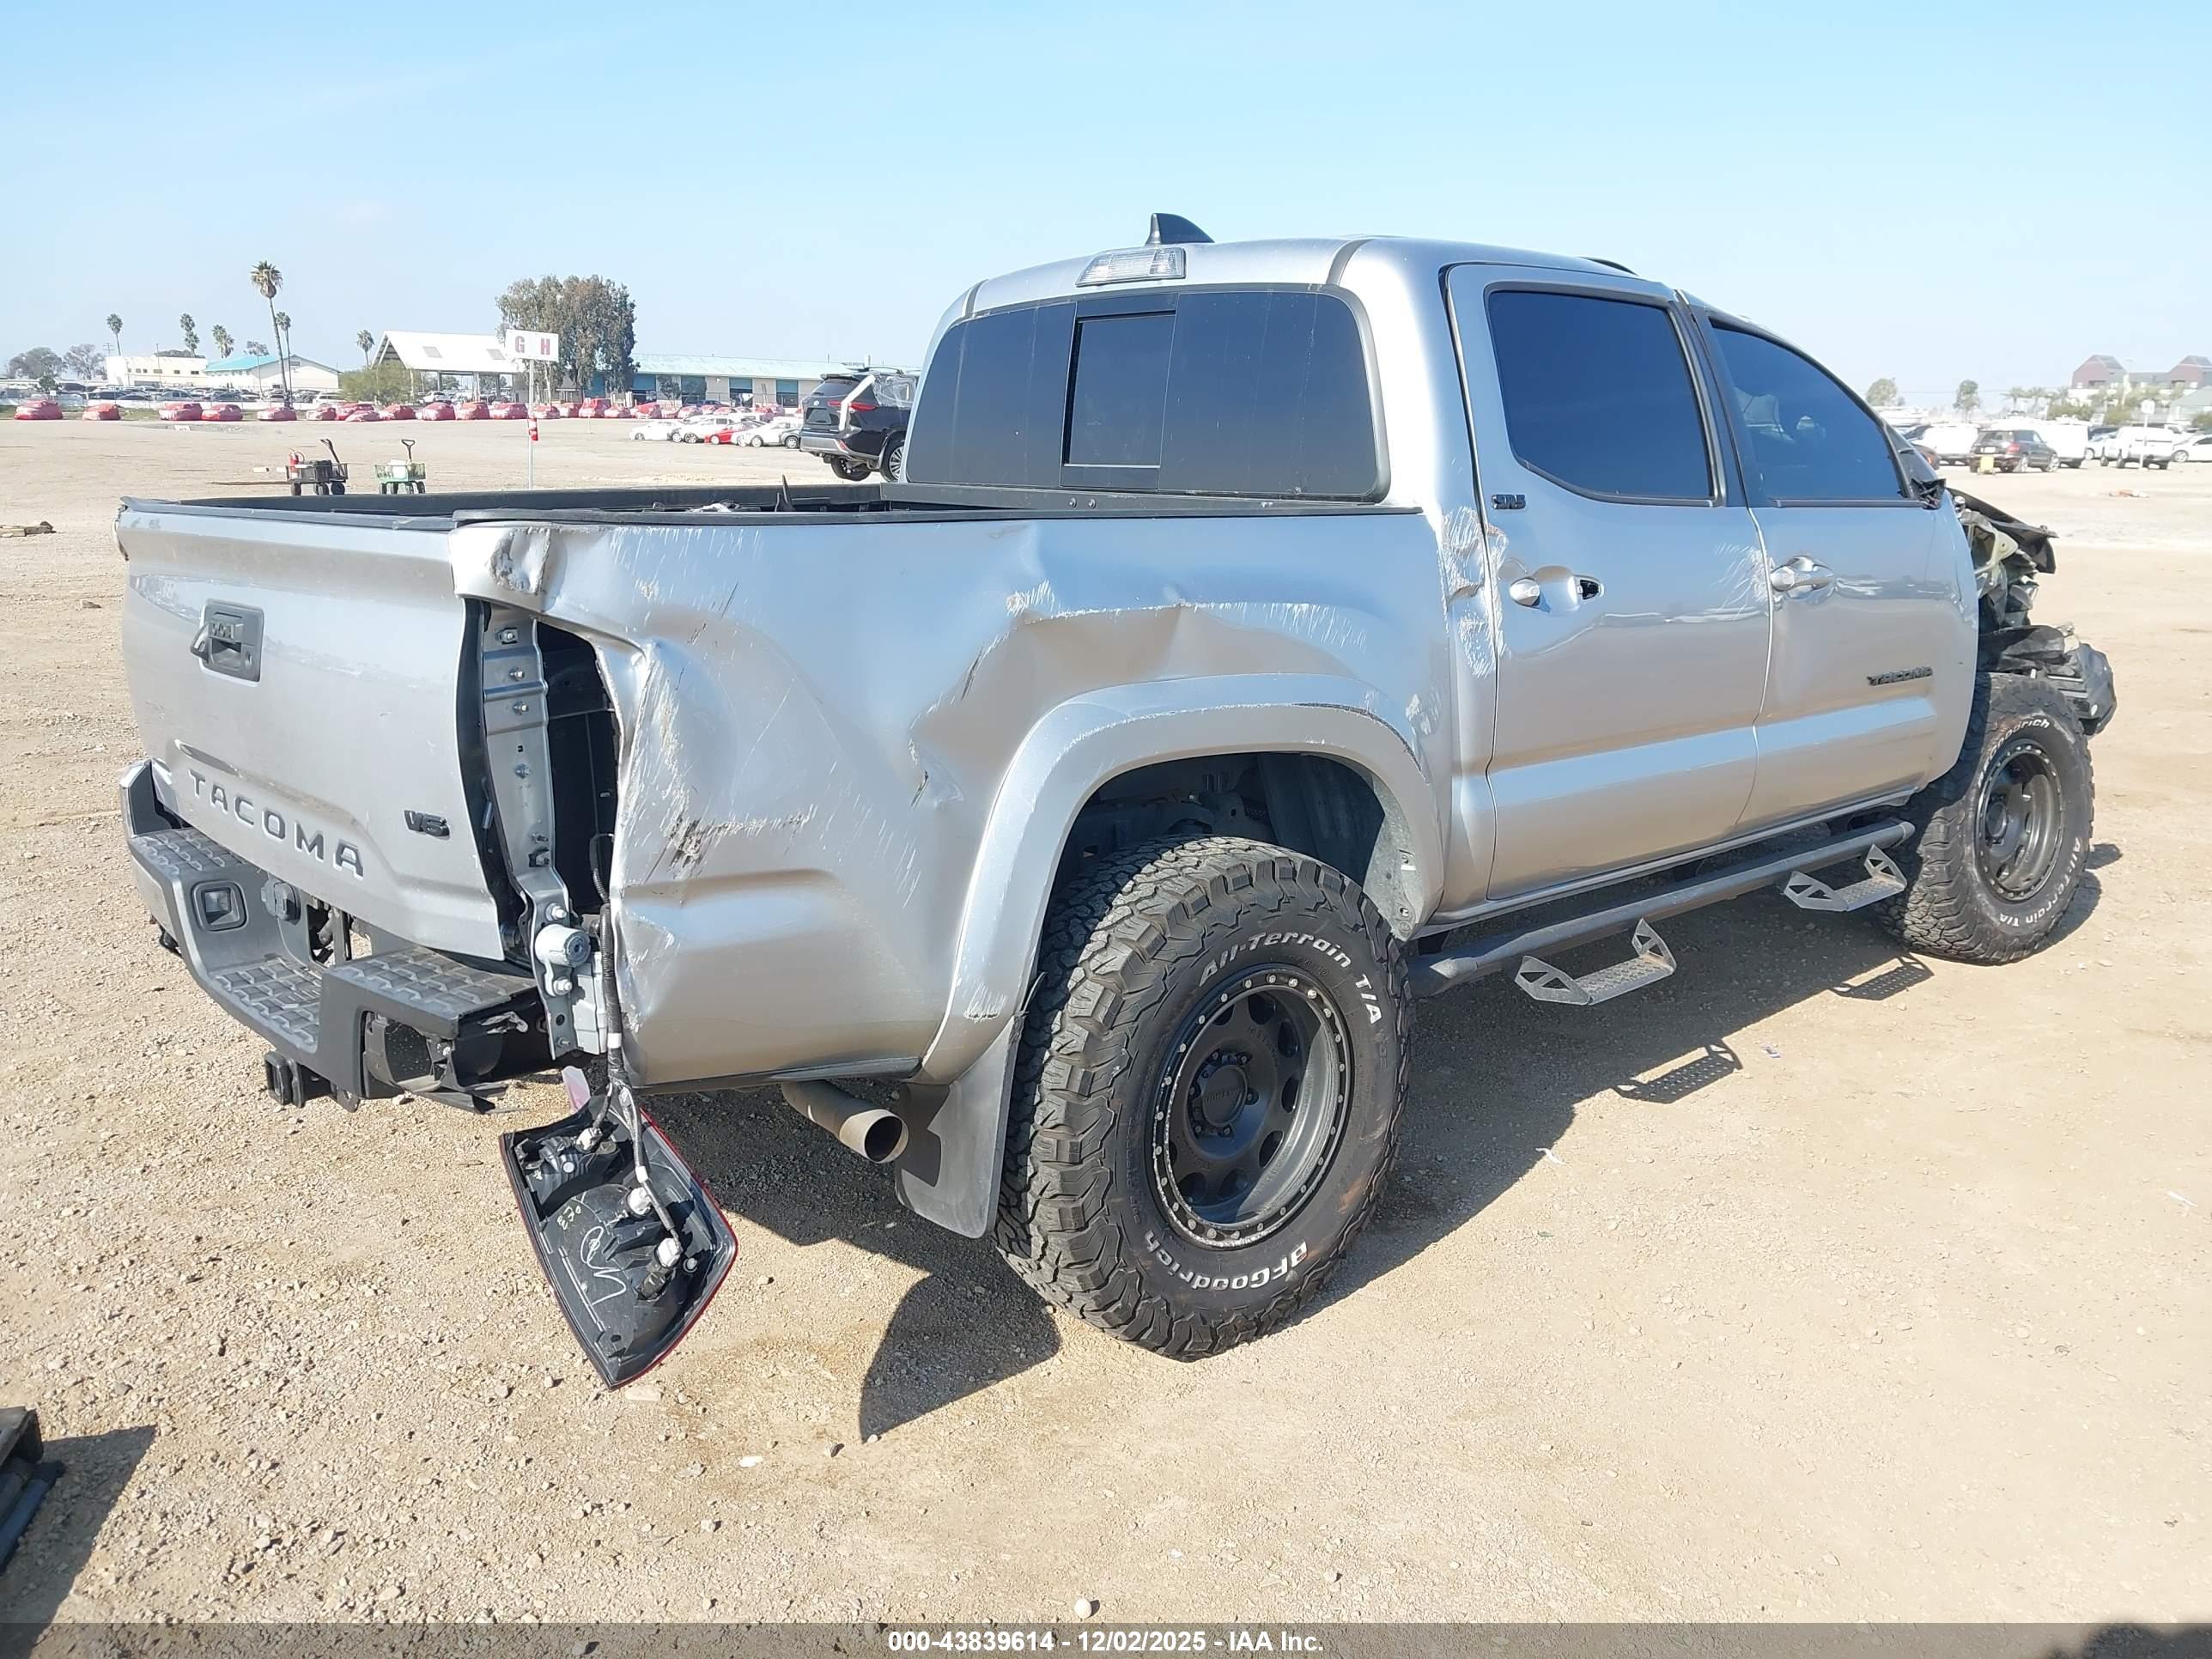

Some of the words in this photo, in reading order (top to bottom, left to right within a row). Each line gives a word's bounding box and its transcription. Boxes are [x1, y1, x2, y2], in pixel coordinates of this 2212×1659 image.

[514, 336, 526, 354] G
[540, 338, 550, 355] H
[188, 769, 365, 879] TACOMA
[404, 810, 450, 838] V6
[1199, 932, 1352, 987] All-Terrain
[1355, 973, 1382, 1024] T/A
[1145, 1230, 1309, 1290] BFGoodrich
